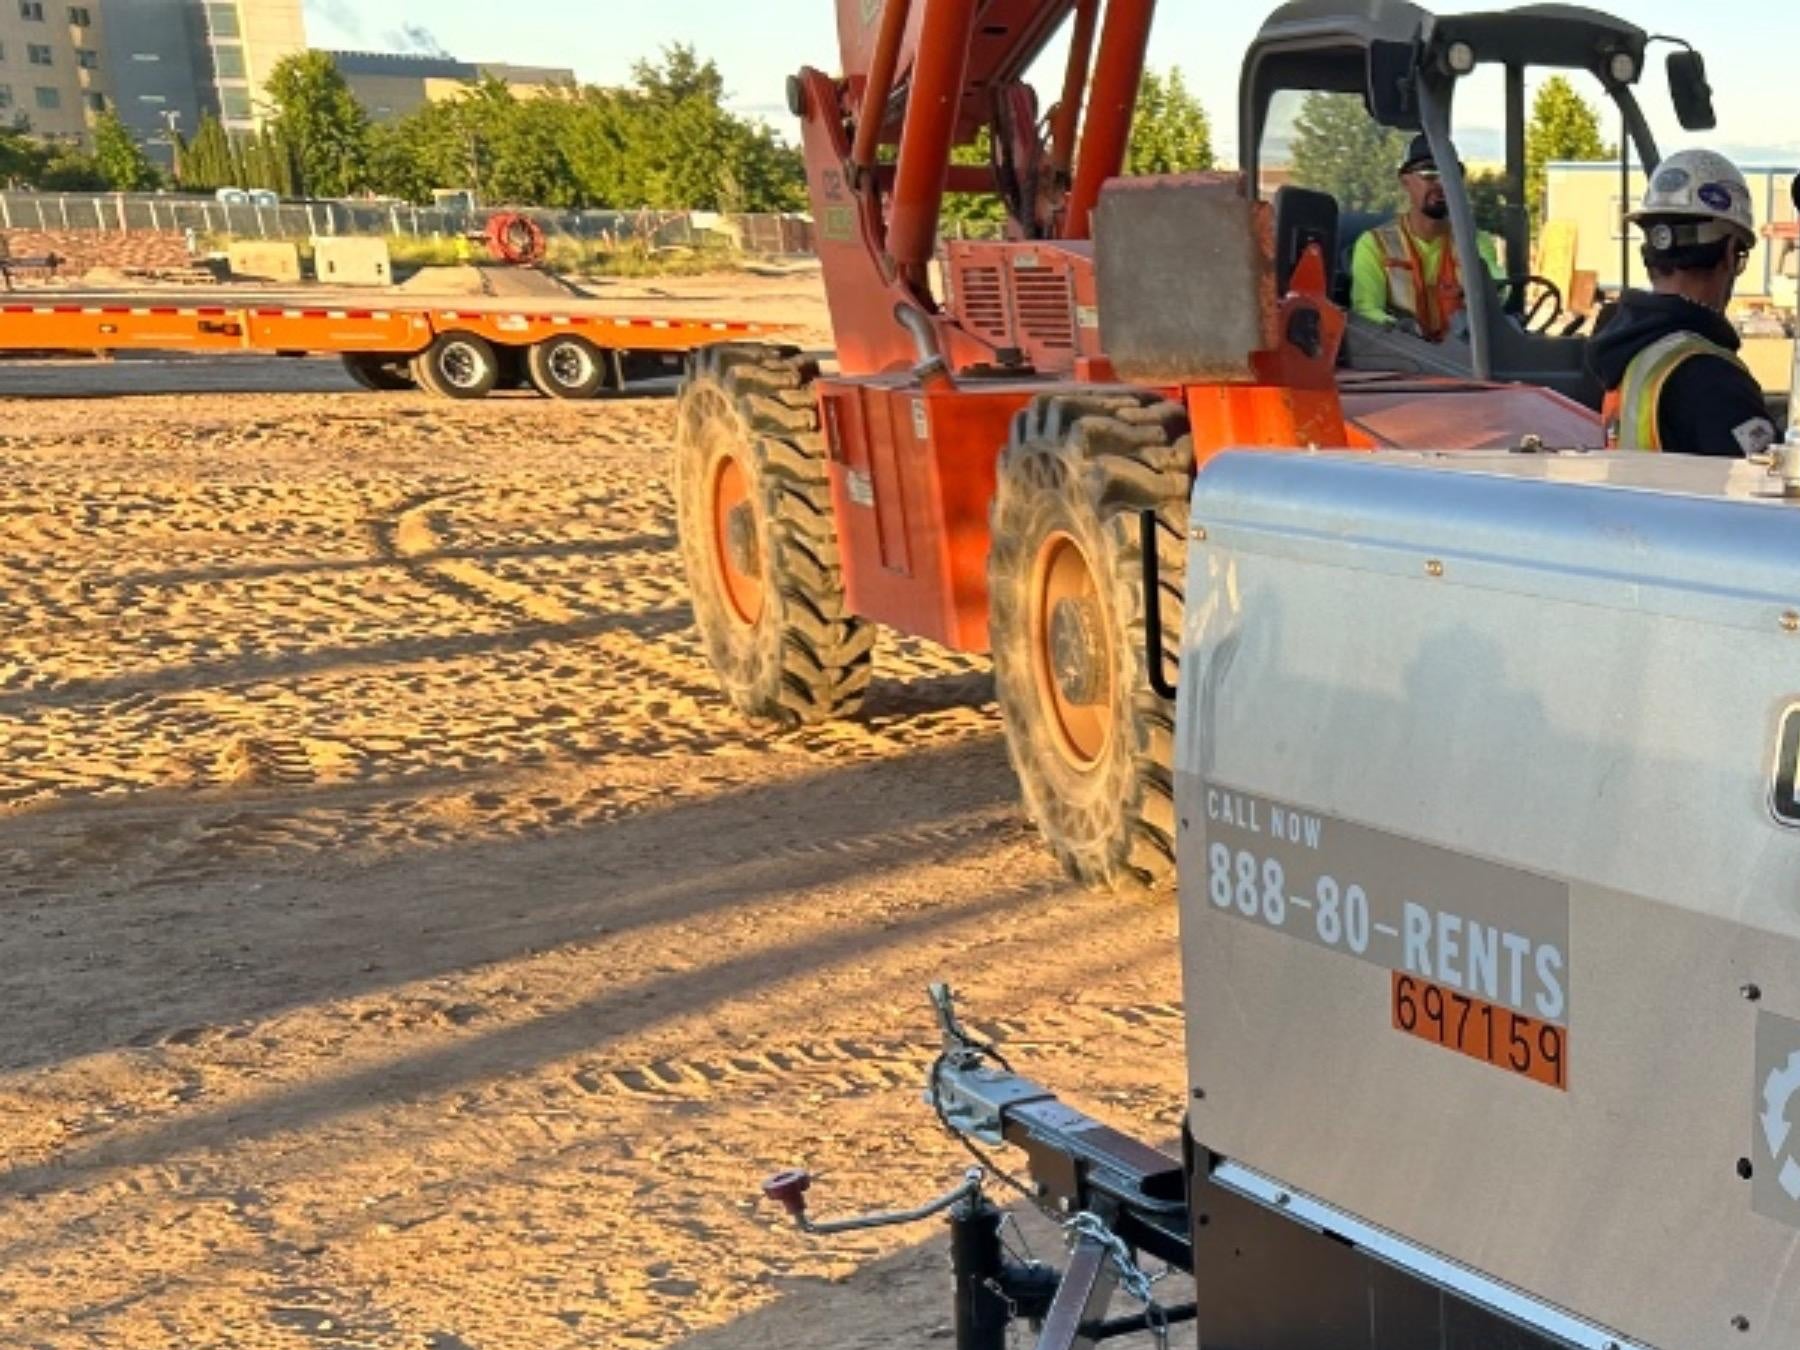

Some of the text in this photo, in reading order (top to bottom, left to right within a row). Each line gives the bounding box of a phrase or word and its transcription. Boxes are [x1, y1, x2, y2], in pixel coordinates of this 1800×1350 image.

[1206, 788, 1322, 851] CALL NOW
[1208, 840, 1566, 1020] 888-80-RENTS
[1394, 975, 1563, 1085] 697159
